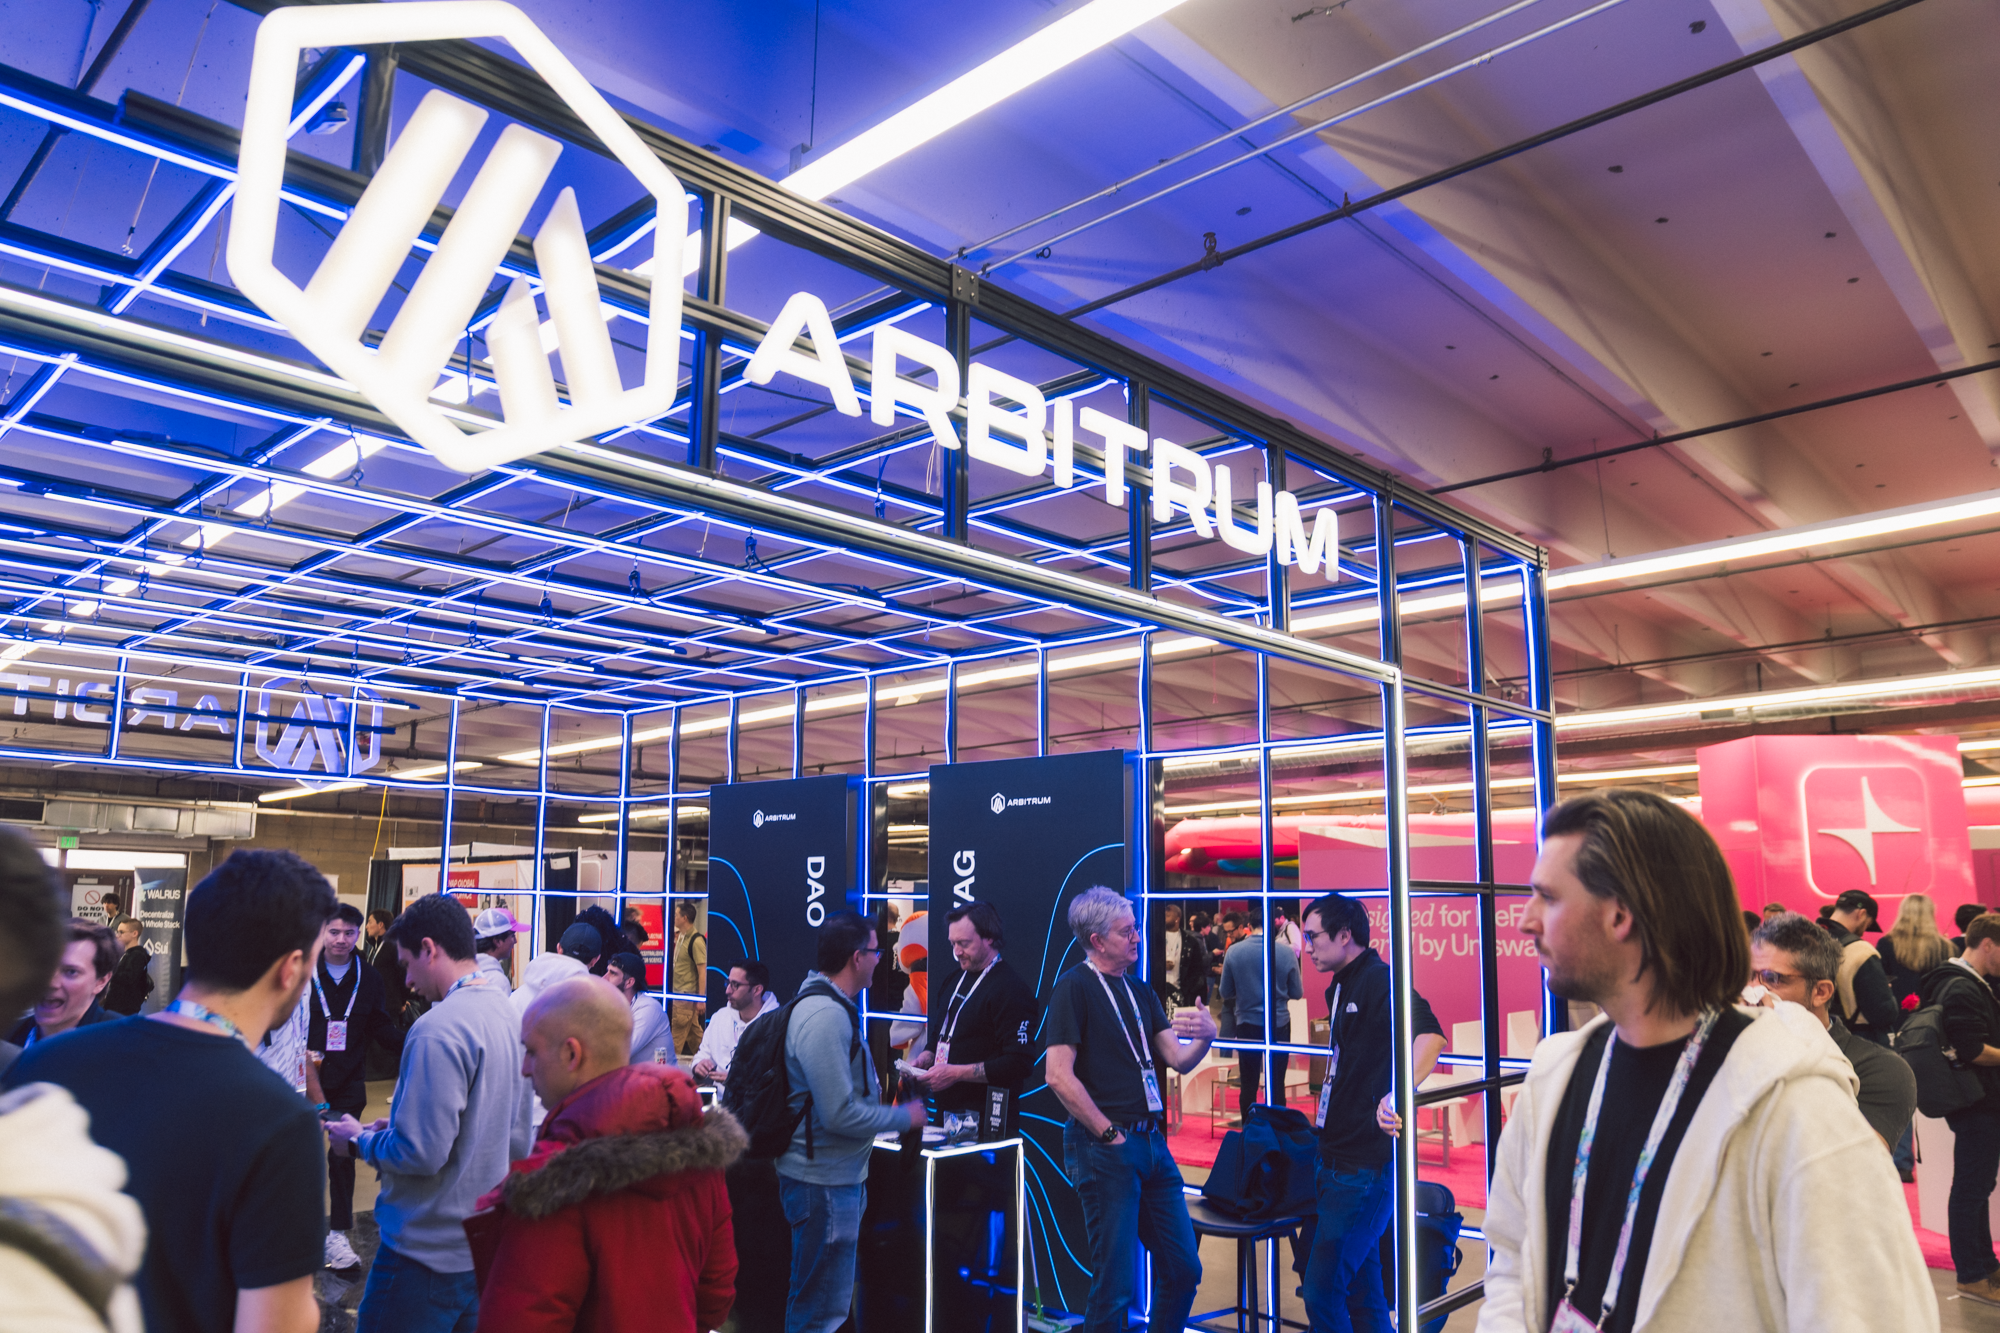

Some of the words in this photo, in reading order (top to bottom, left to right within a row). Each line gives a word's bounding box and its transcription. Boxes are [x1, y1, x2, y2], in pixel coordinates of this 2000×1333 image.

[742, 291, 1339, 582] ARBITRUM
[1007, 796, 1052, 807] ARBITRUM
[764, 813, 796, 822] ARBITRUM
[61, 836, 77, 848] EXIT
[147, 889, 181, 900] WALRUS
[806, 856, 825, 927] DAO
[140, 910, 174, 920] Decentralize
[1368, 903, 1435, 933] siged
[1439, 904, 1472, 927] for
[145, 920, 163, 929] Whole
[164, 920, 181, 929] Stack
[154, 941, 169, 955] Sui
[1419, 933, 1447, 961] by
